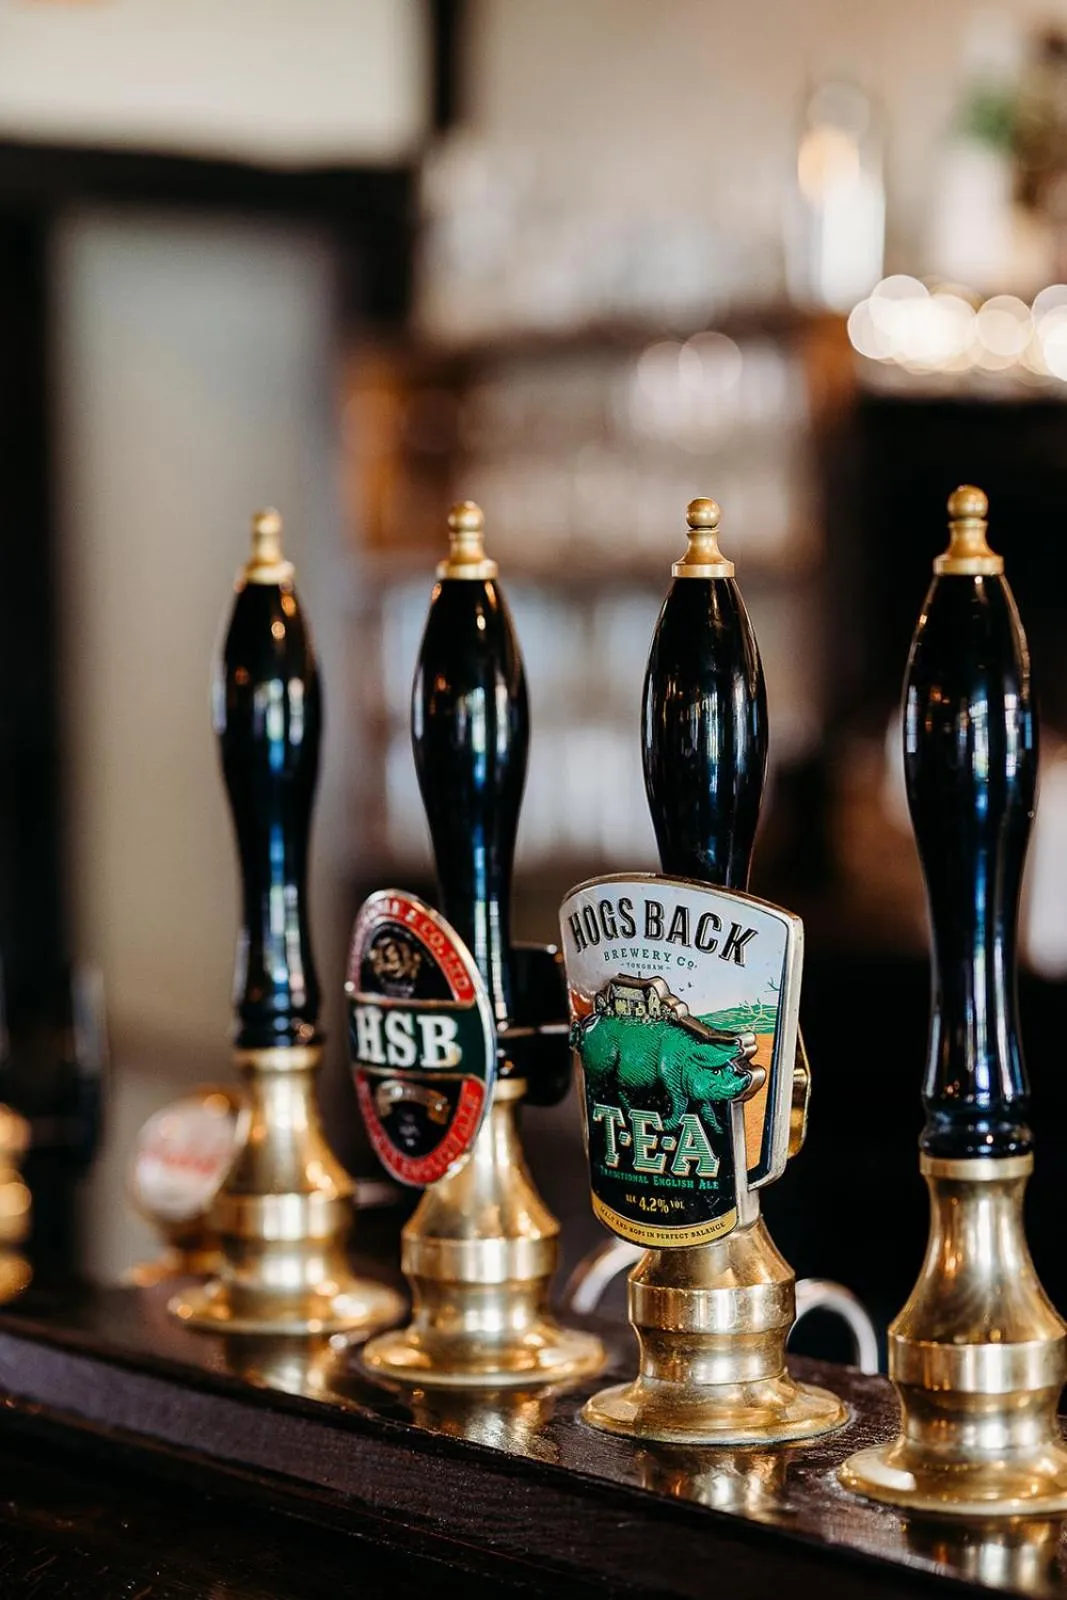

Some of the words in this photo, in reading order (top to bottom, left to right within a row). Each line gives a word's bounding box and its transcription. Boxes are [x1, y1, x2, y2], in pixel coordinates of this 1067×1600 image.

[569, 897, 637, 953] HOGS
[643, 899, 759, 968] BACK
[603, 948, 672, 963] BREWERY
[353, 1005, 463, 1069] HSB
[698, 1178, 719, 1190] ALE
[638, 1196, 669, 1214] 4.2%
[646, 1231, 656, 1239] IN
[656, 1231, 689, 1240] PERFECT
[691, 1221, 726, 1239] BALANCE
